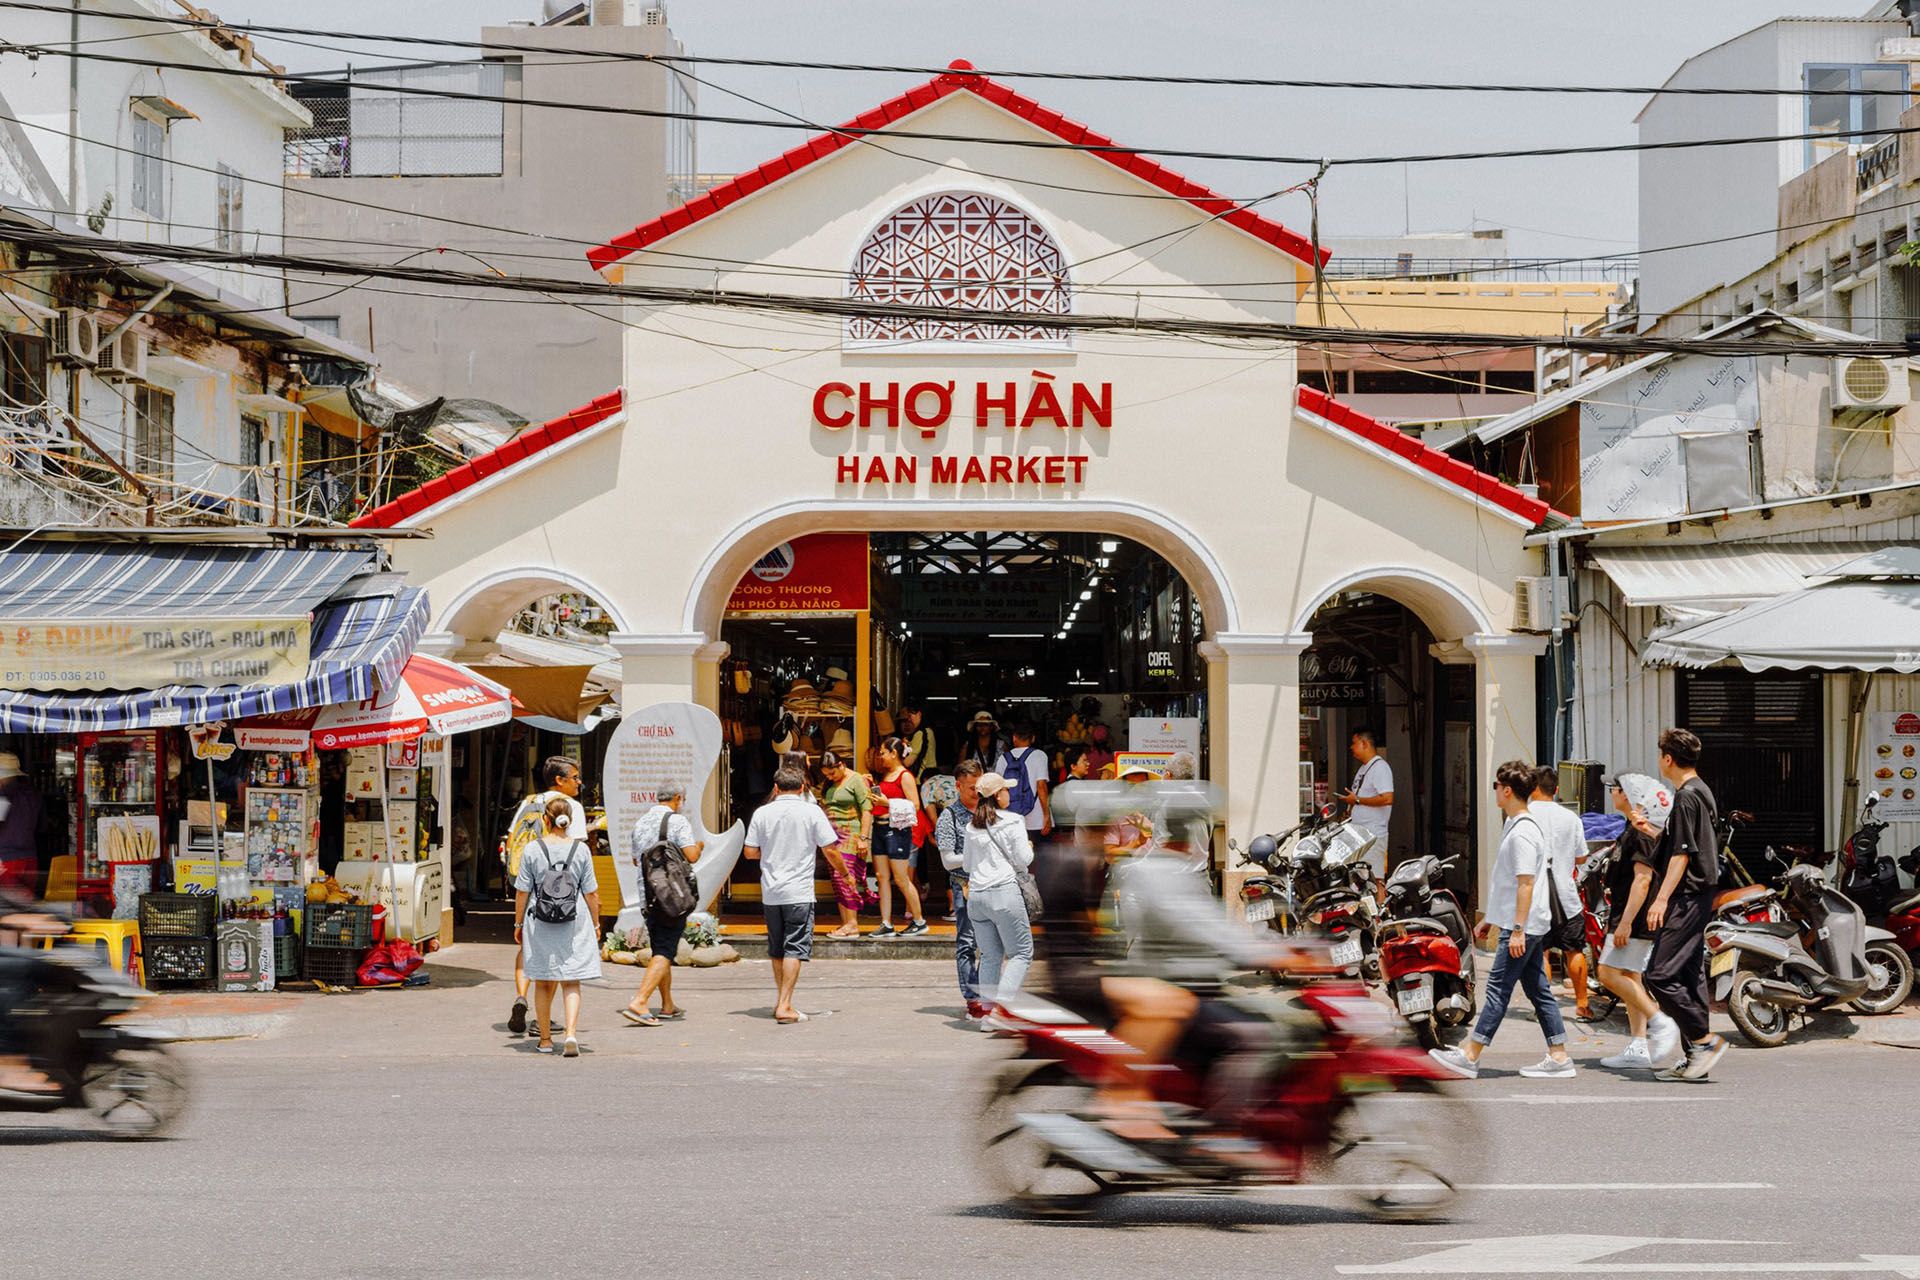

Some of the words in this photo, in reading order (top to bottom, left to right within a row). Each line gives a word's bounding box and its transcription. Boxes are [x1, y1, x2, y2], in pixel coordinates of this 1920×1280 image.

[813, 380, 955, 438] CHỢ
[976, 370, 1112, 427] HÀN
[837, 455, 917, 483] HAN
[932, 455, 1089, 483] MARKET
[779, 585, 832, 594] THƯƠNG
[749, 597, 776, 609] PHỐ
[780, 598, 797, 609] ĐÀ
[143, 628, 175, 648] TRÀ
[233, 631, 264, 648] RAU
[271, 627, 297, 648] MÁ
[86, 671, 105, 681] 210
[211, 660, 269, 678] CHANH
[1344, 685, 1366, 700] Spa
[339, 726, 420, 742] www.kemhunglinh.com
